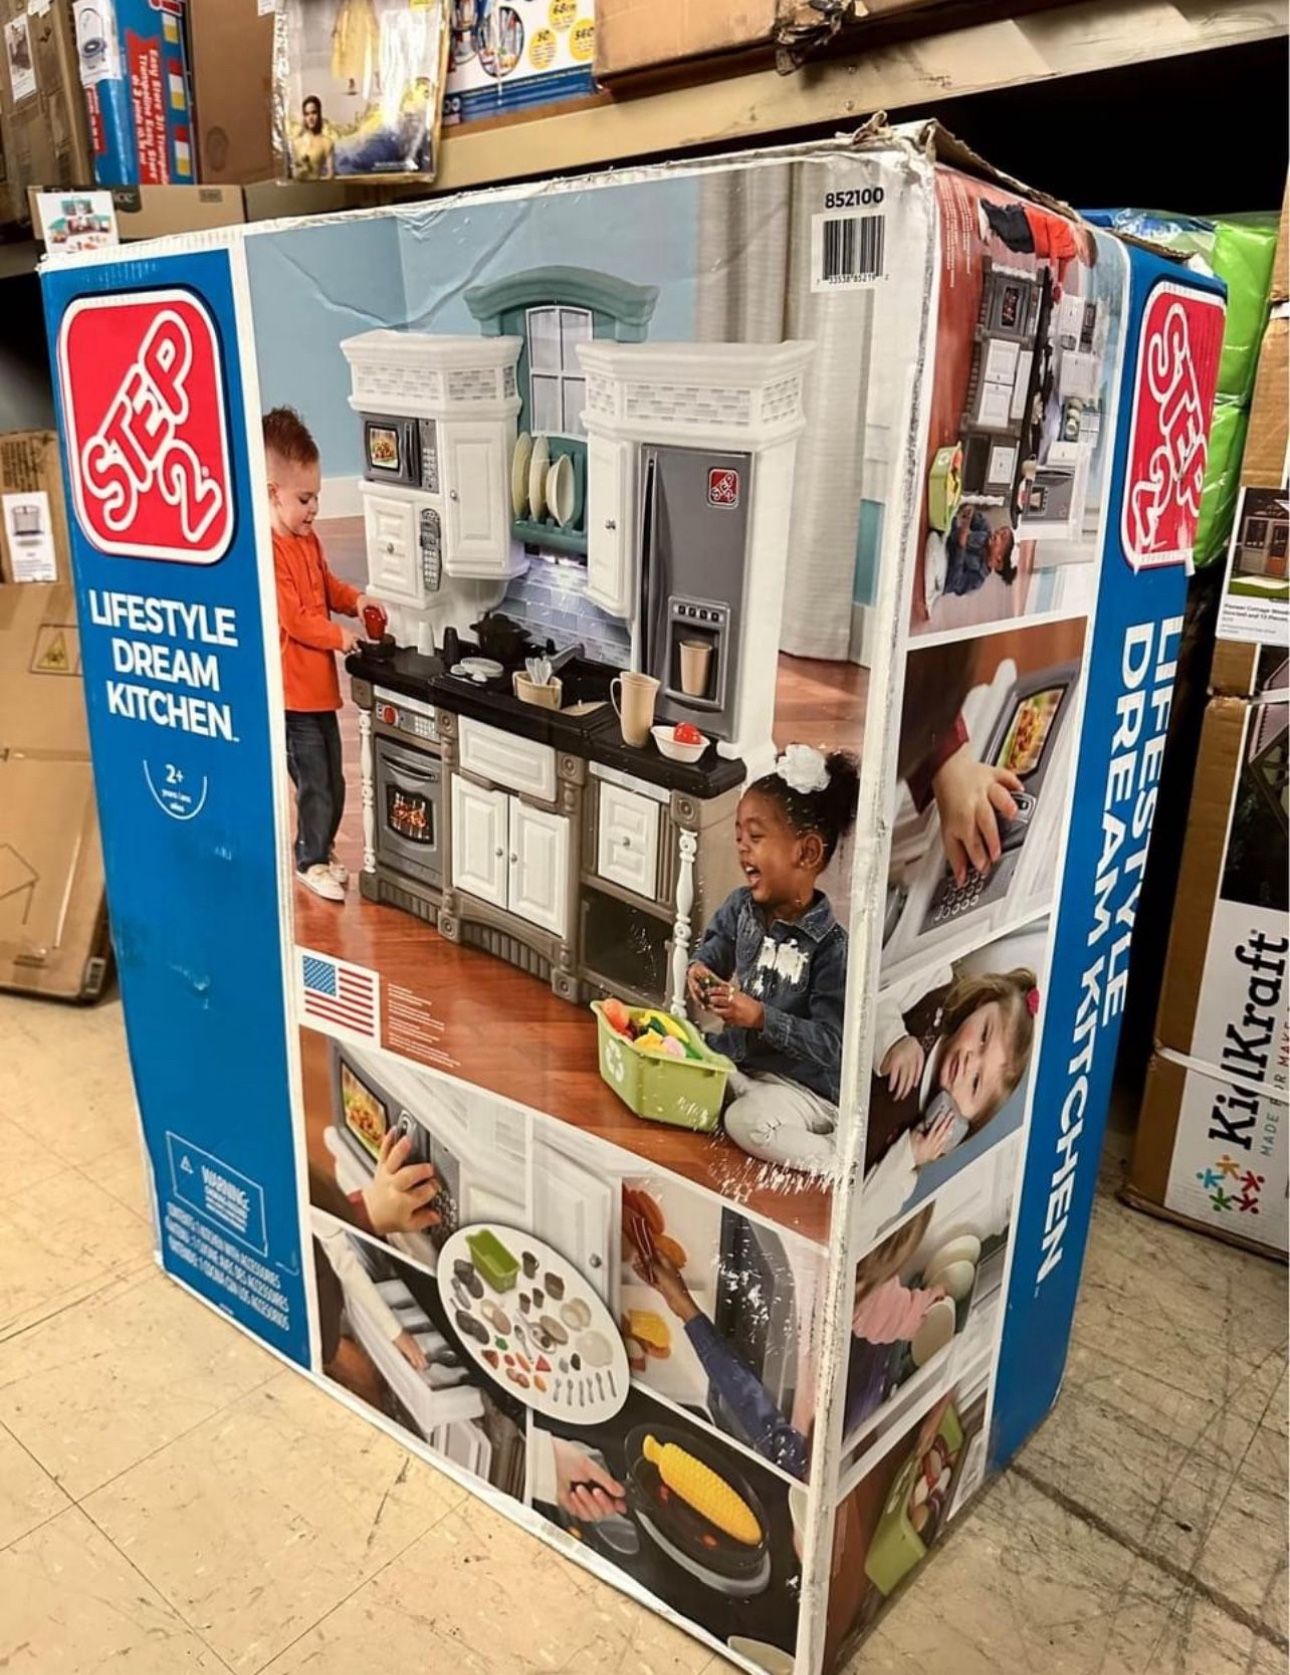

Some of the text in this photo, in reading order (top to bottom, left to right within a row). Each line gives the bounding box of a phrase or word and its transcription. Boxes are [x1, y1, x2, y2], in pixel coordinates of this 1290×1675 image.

[825, 187, 885, 209] 852100
[81, 309, 223, 543] STEP 2
[88, 589, 239, 647] LIFESTYLE
[111, 637, 220, 692] DREAM
[164, 764, 185, 785] 2+
[1087, 622, 1155, 947] DREAM
[1103, 614, 1184, 1027] LIFESTYLE
[1259, 1112, 1280, 1158] MADE
